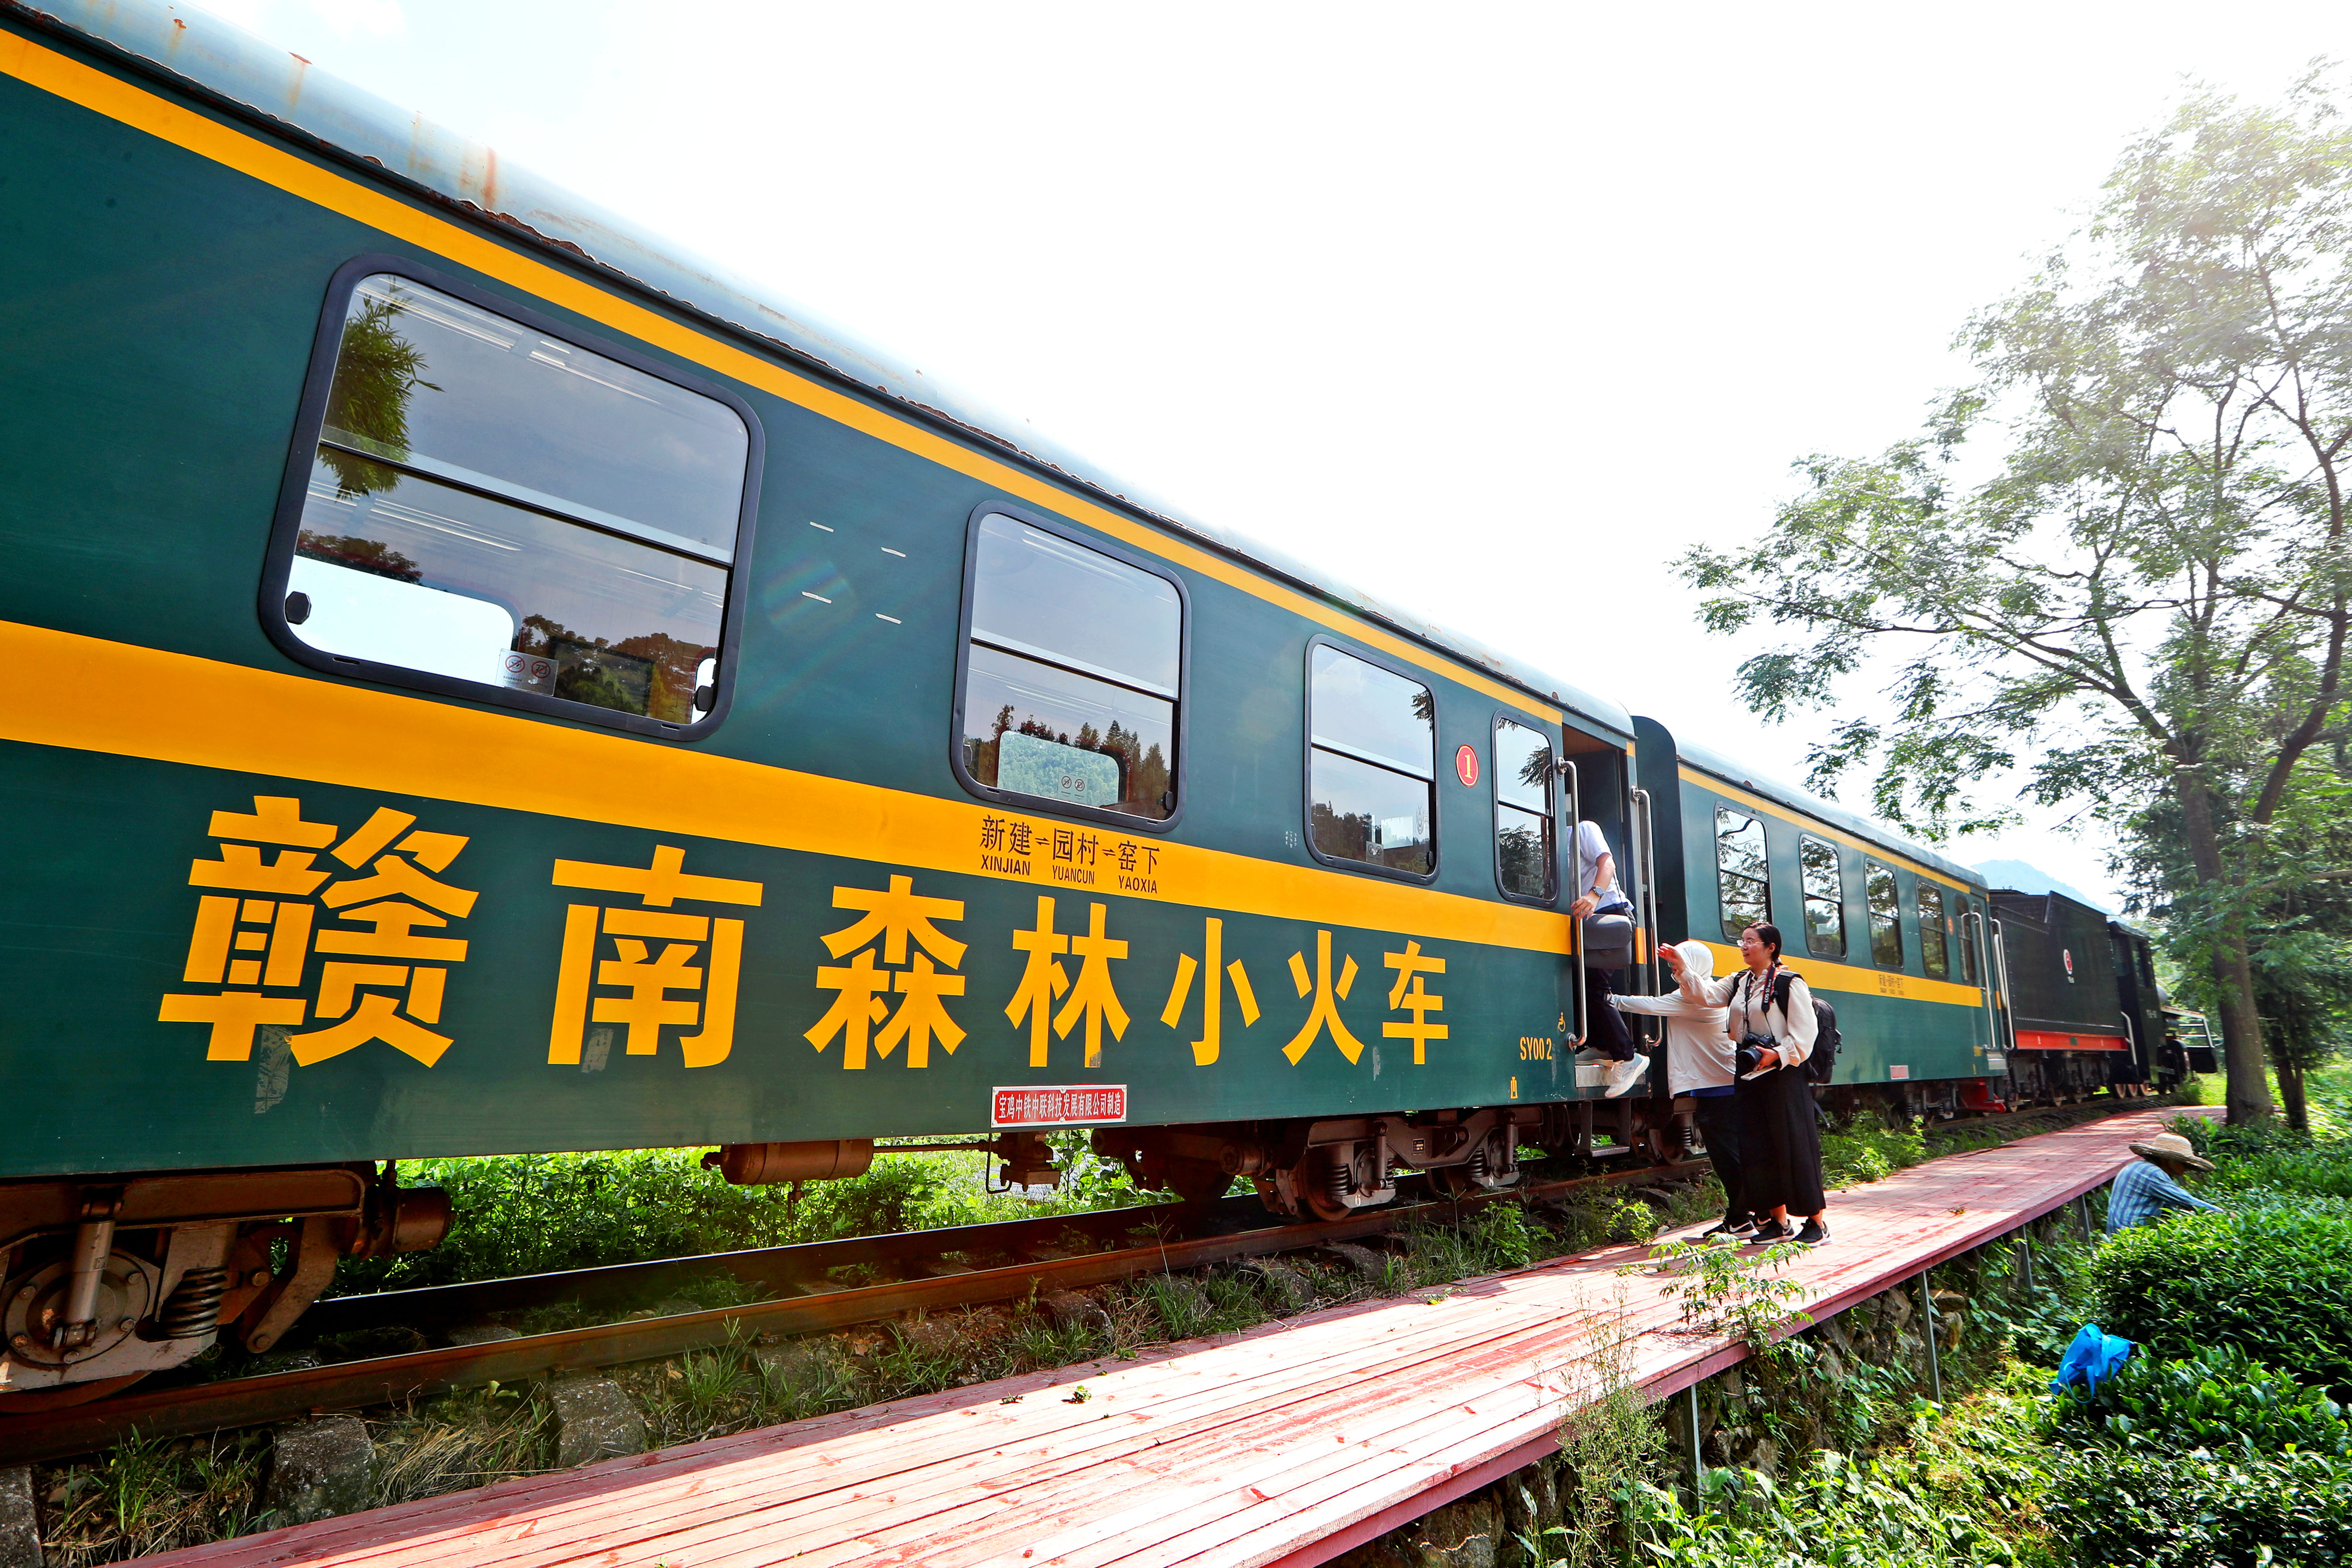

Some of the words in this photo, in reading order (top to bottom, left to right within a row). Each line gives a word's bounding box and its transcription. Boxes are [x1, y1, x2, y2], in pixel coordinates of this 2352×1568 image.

[1464, 754, 1473, 779] 1
[979, 814, 1032, 856] 新建
[1053, 827, 1099, 866] 园村
[1118, 840, 1160, 875] 窑下
[981, 854, 1030, 876] XINJIAN
[1052, 865, 1095, 885] YUANCUN
[1118, 875, 1158, 894] YAOXIA
[158, 795, 1449, 1070] 赣南森林小火车
[998, 1092, 1121, 1120] 宝鸡中铁中联科技发展有限公司制造
